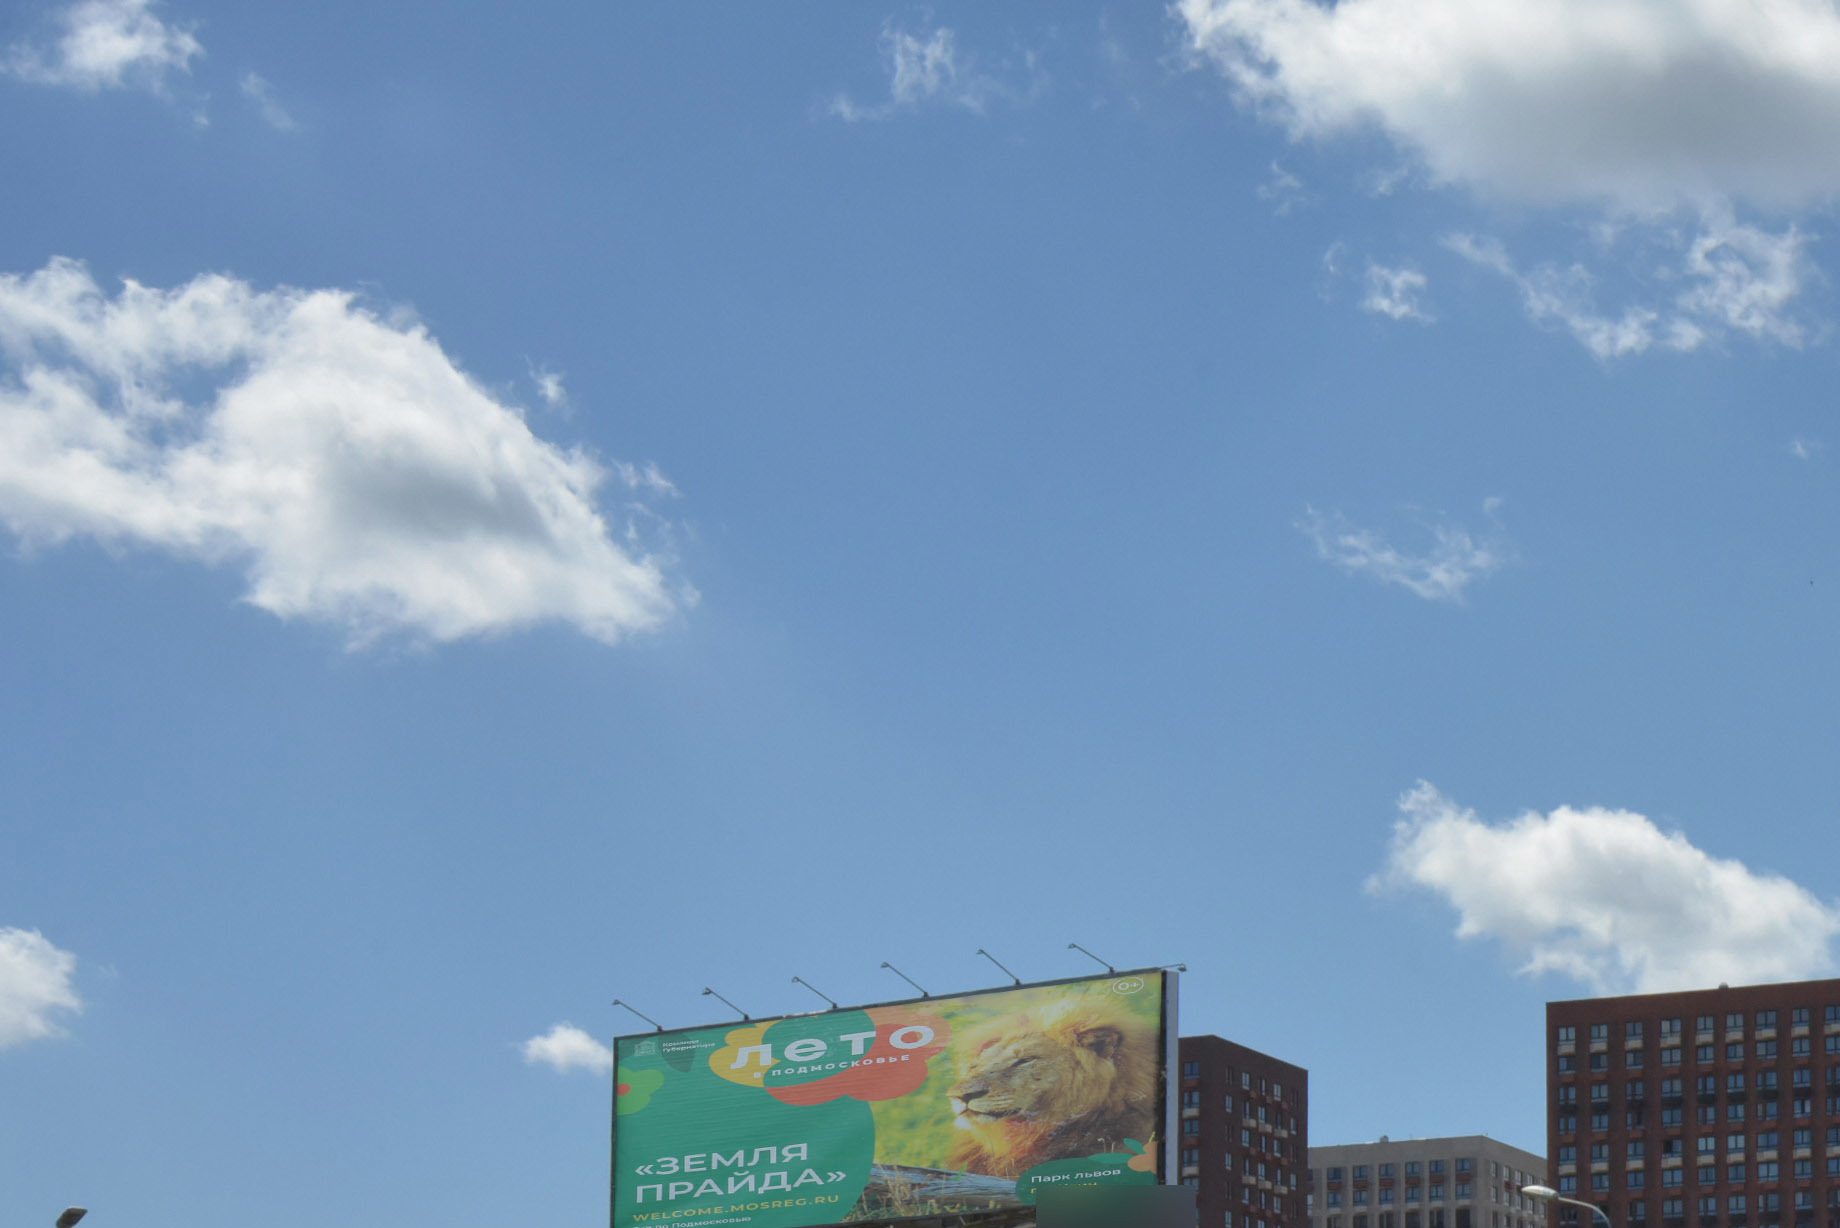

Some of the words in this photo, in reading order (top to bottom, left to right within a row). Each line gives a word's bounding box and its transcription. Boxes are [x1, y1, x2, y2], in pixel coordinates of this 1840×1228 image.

[635, 1143, 808, 1175] «ЗЕМЛЯ
[636, 1168, 847, 1203] ПРАЙДА»
[1031, 1174, 1070, 1183] Парк
[1074, 1169, 1121, 1179] львов
[633, 1195, 840, 1222] WELCOME.MOSREG.RU
[672, 1216, 751, 1228] Подмосковью
